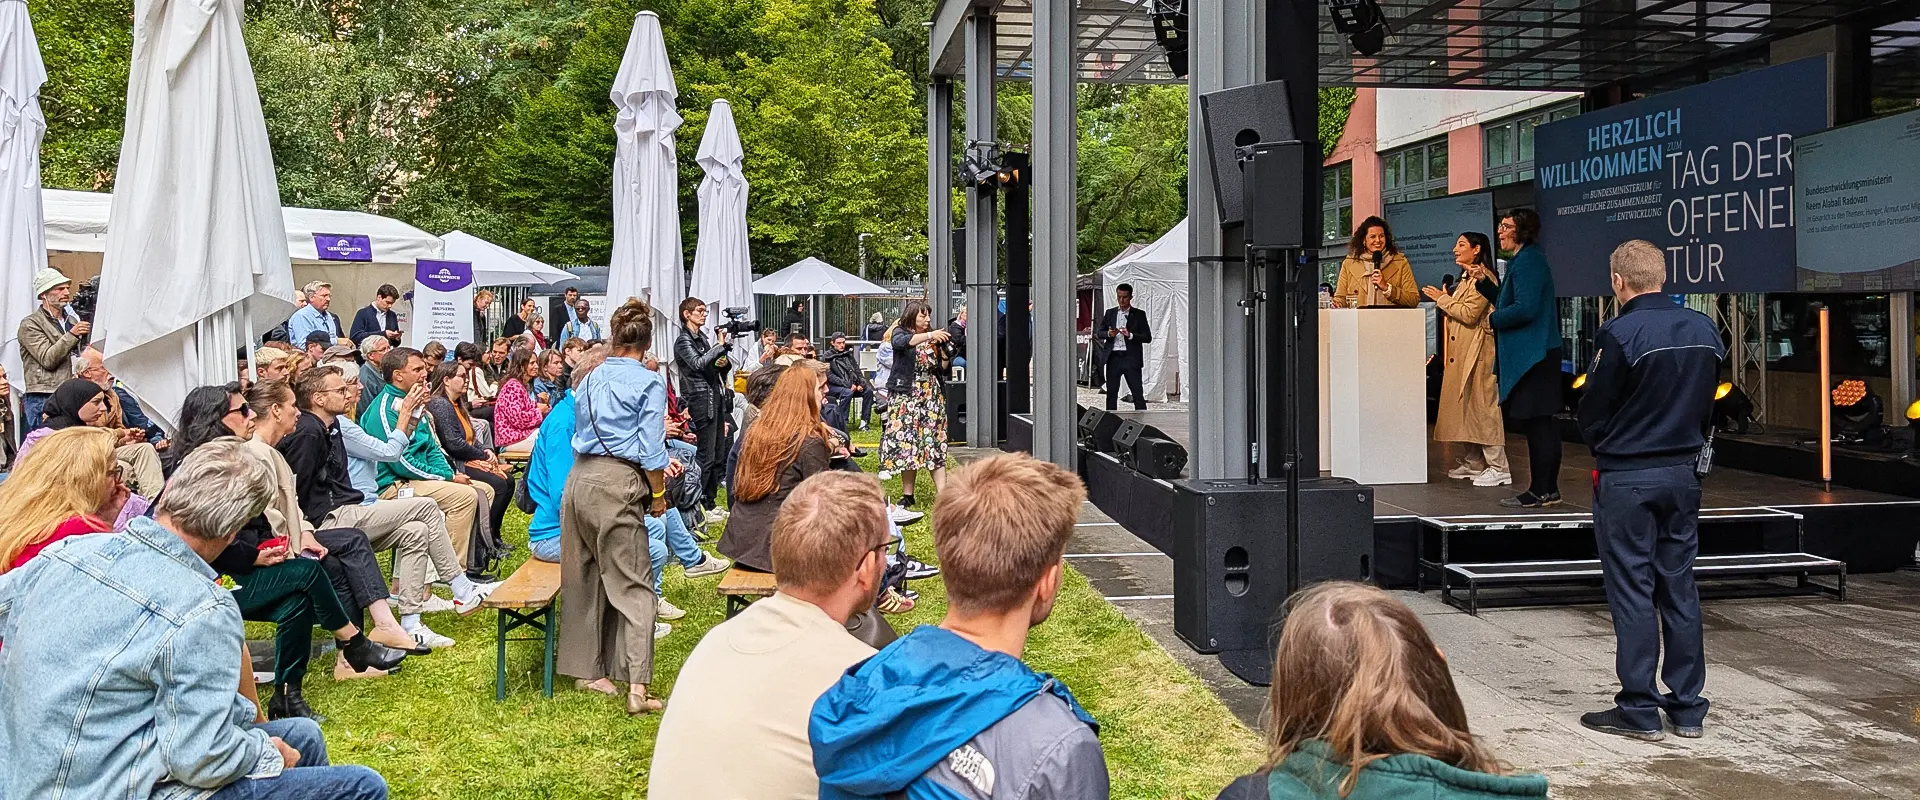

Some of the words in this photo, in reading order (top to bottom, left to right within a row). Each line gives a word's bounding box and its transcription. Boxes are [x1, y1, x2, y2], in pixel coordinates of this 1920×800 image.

[1588, 108, 1681, 152] HERZLICH
[1666, 140, 1683, 152] ZUM
[1540, 144, 1662, 189] WILLKOMMEN
[1666, 145, 1720, 190] TAG
[1732, 133, 1793, 182] DER
[1590, 181, 1653, 199] BUNDESMINISTERIUM
[1652, 181, 1662, 192] für
[1805, 174, 1893, 197] Bundesentwicklungsministerin
[1556, 201, 1607, 216] WIRTSCHAFTLICHE
[1606, 193, 1663, 209] ZUSAMMENARBEIT
[1667, 185, 1794, 237] OFFENE
[1842, 194, 1868, 207] Radovan
[1616, 207, 1663, 221] ENTWICKLUNG
[1666, 237, 1725, 284] TÜR
[964, 745, 985, 763] THE
